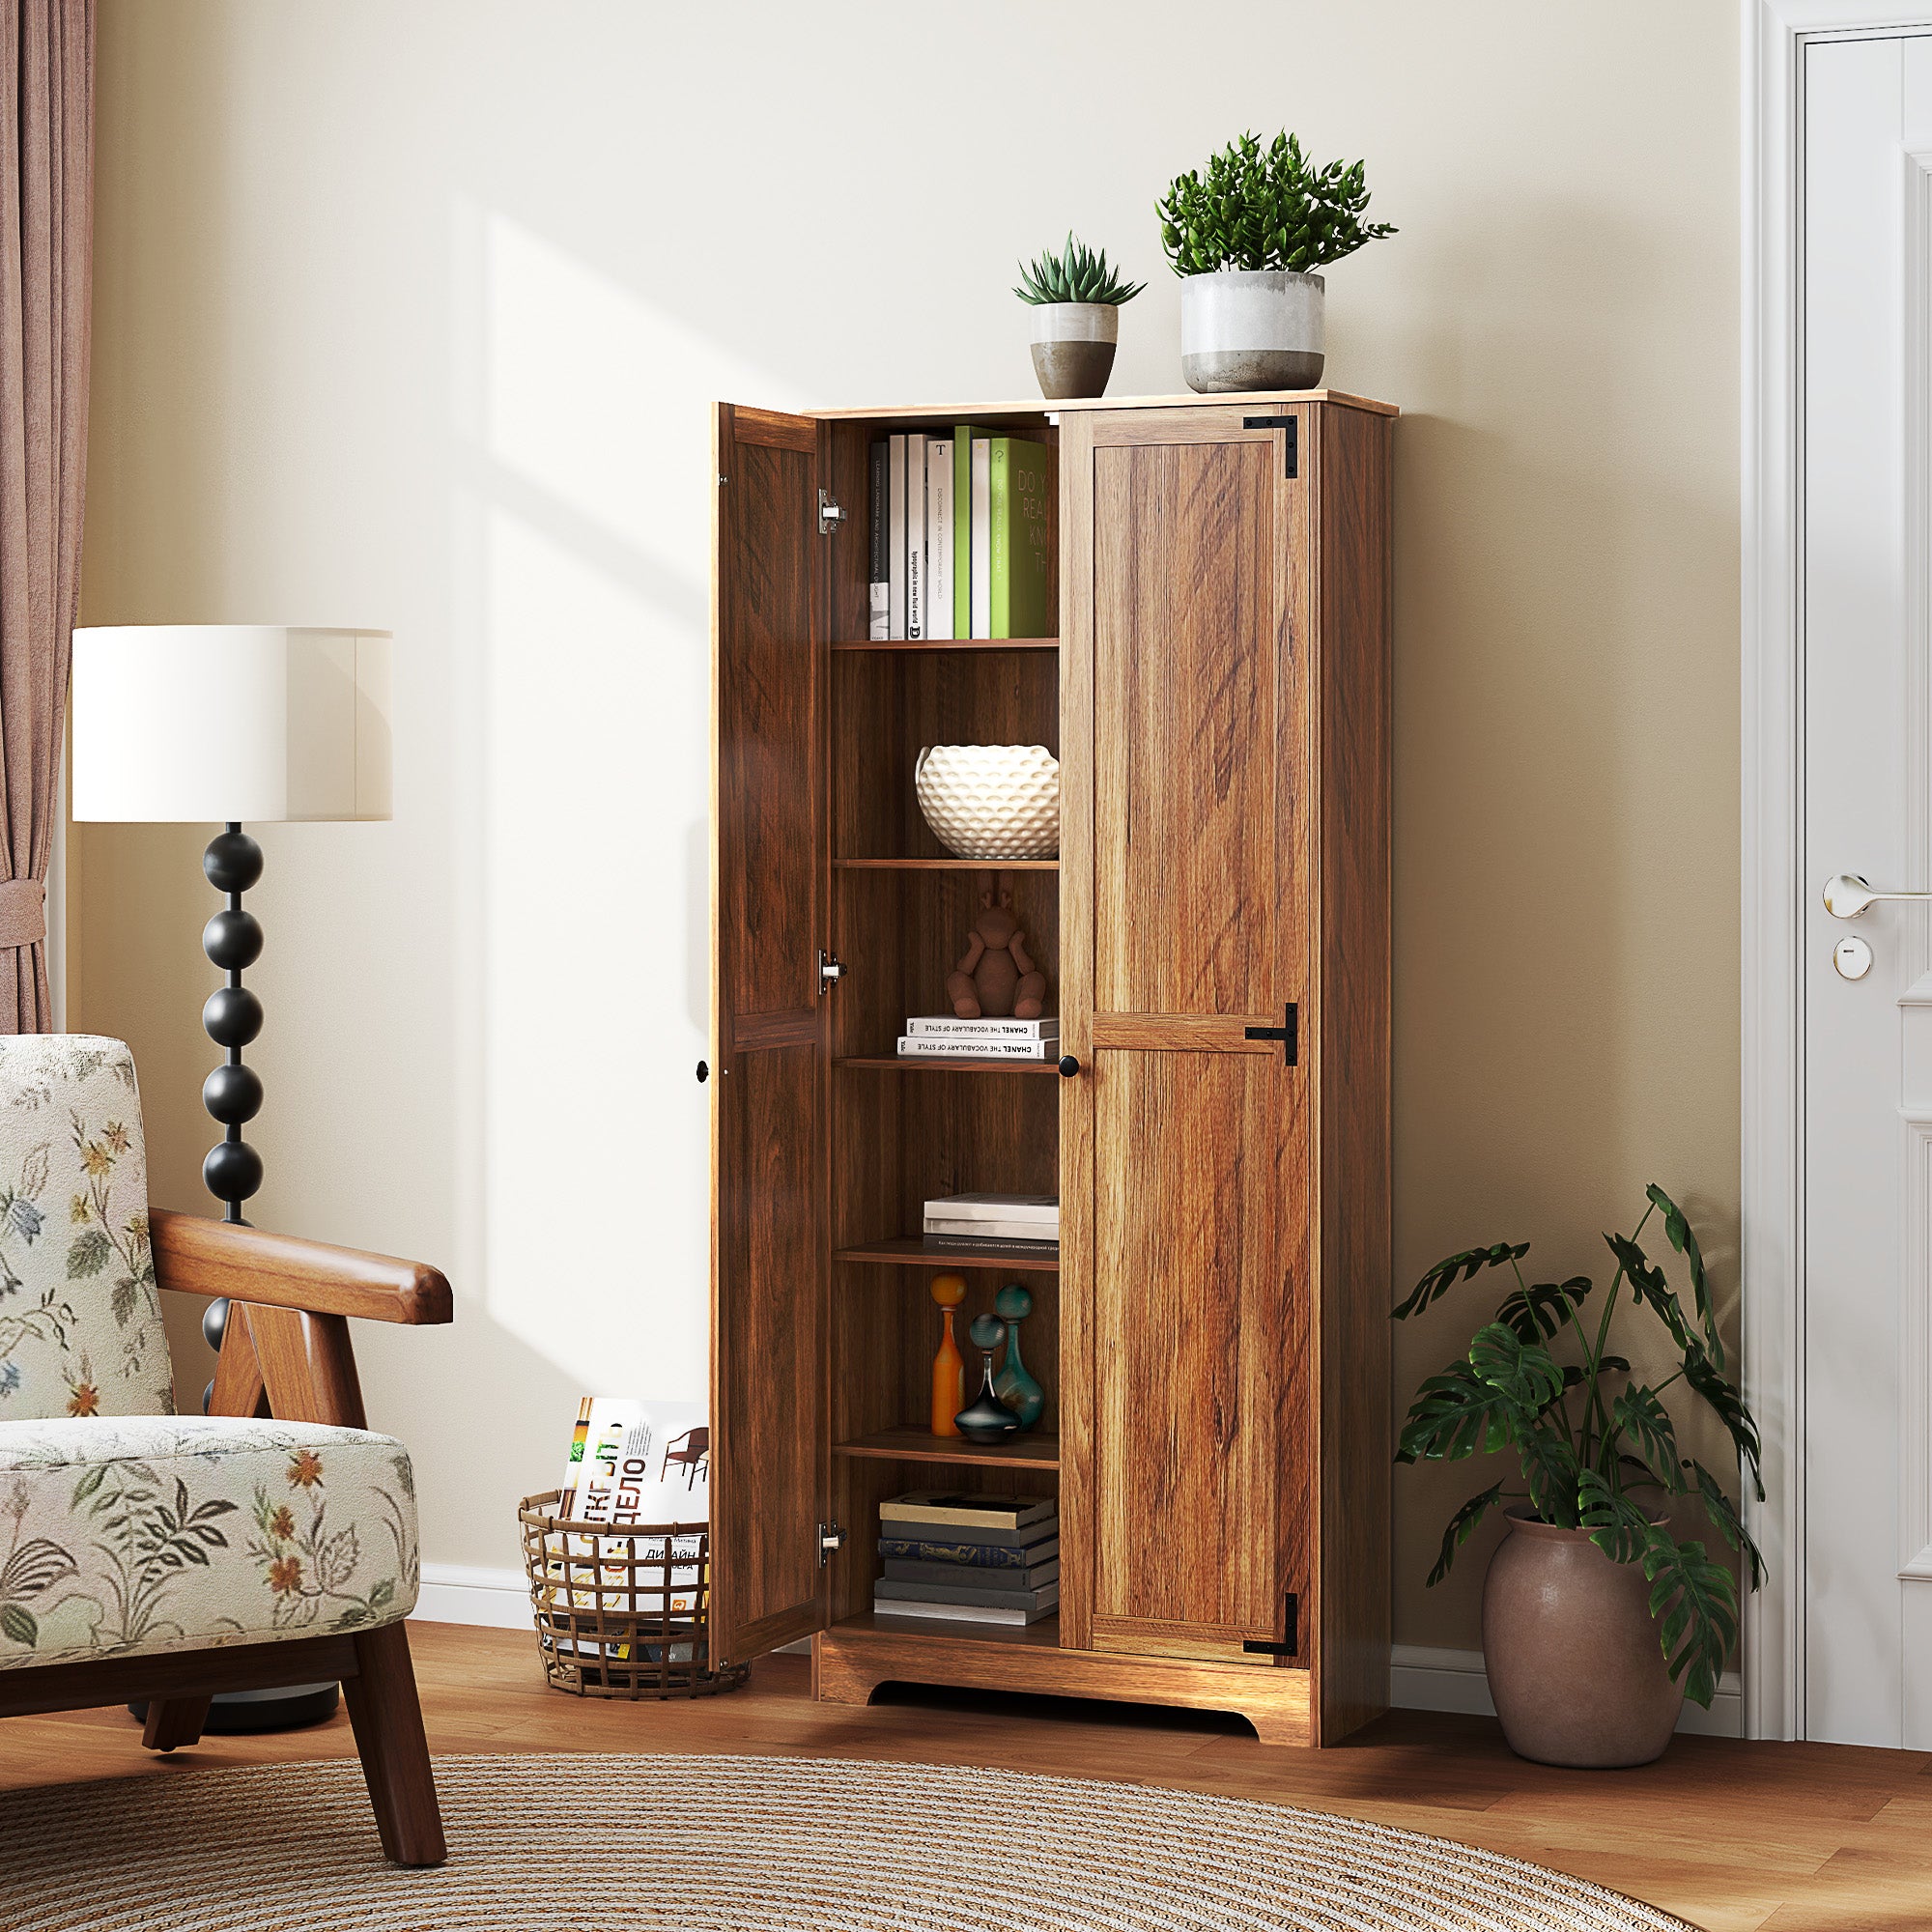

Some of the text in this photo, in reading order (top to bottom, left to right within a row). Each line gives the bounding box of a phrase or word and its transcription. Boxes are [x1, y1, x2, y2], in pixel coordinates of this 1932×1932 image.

[936, 444, 946, 456] T
[1018, 469, 1036, 493] DO
[645, 1548, 696, 1559] ДИАЙН
